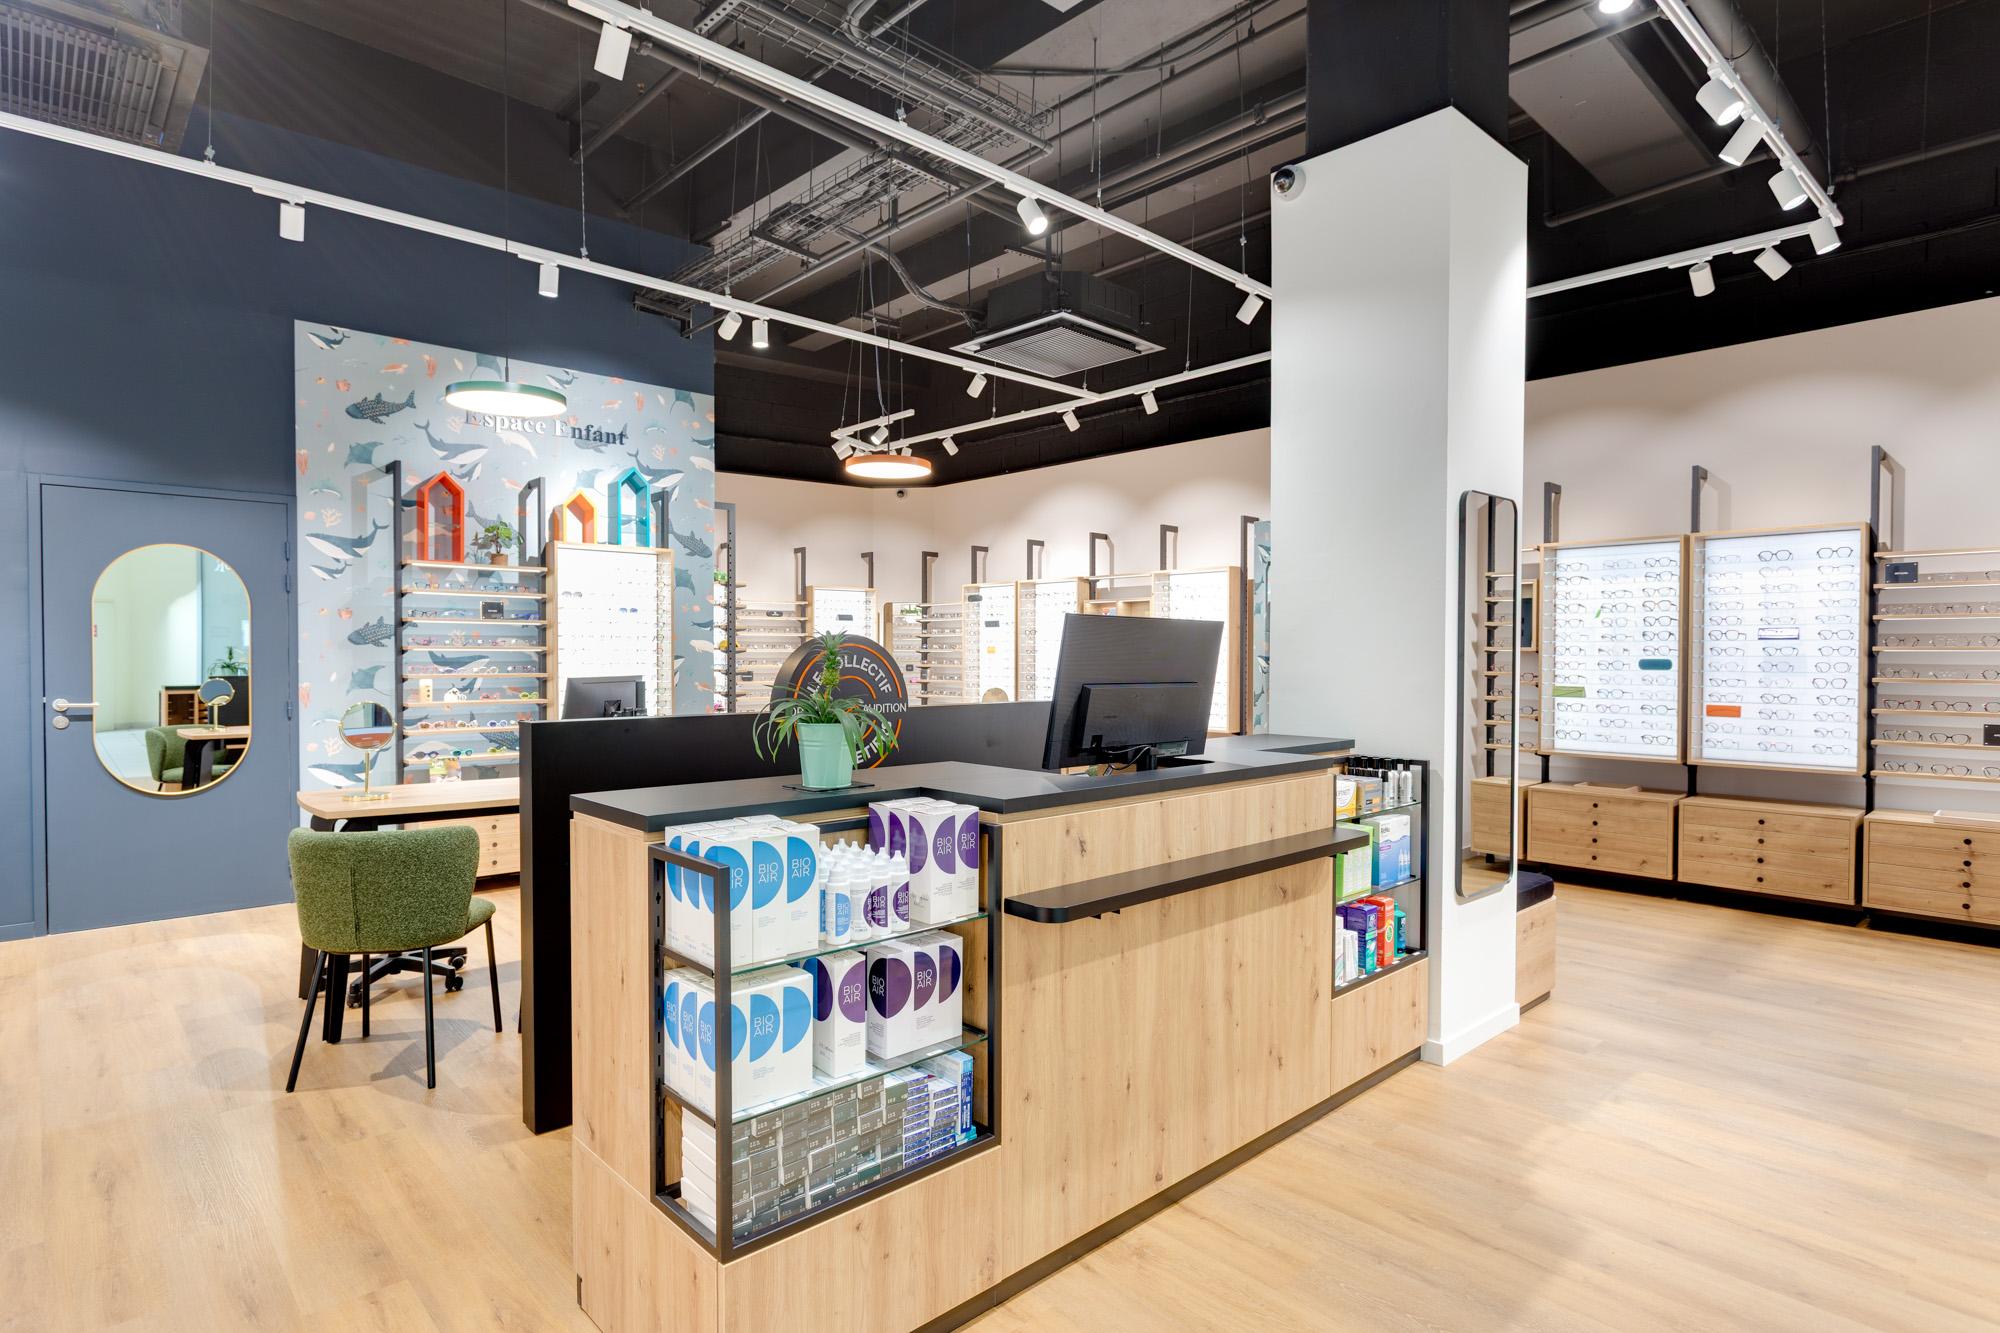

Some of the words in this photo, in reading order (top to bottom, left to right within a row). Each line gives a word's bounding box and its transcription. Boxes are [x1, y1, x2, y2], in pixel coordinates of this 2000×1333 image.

[465, 411, 547, 434] Espace
[553, 418, 626, 446] Enfant
[835, 655, 892, 694] OLLECTIF
[936, 836, 953, 847] BIO
[961, 832, 976, 842] BIO
[937, 846, 952, 855] AIR
[961, 841, 976, 850] AIR
[758, 862, 779, 874] BIO
[791, 857, 811, 869] BIO
[731, 867, 744, 878] IO
[758, 873, 778, 884] AIR
[791, 867, 810, 878] AIR
[731, 877, 744, 889] IR
[917, 969, 933, 981] BIO
[871, 975, 885, 988] BIO
[917, 979, 932, 990] AIR
[843, 983, 861, 996] BIO
[871, 986, 885, 997] AIR
[843, 993, 861, 1005] AIR
[700, 1020, 712, 1034] BIO
[754, 1014, 774, 1028] BIO
[754, 1025, 774, 1037] AIR
[700, 1032, 712, 1045] AIR
